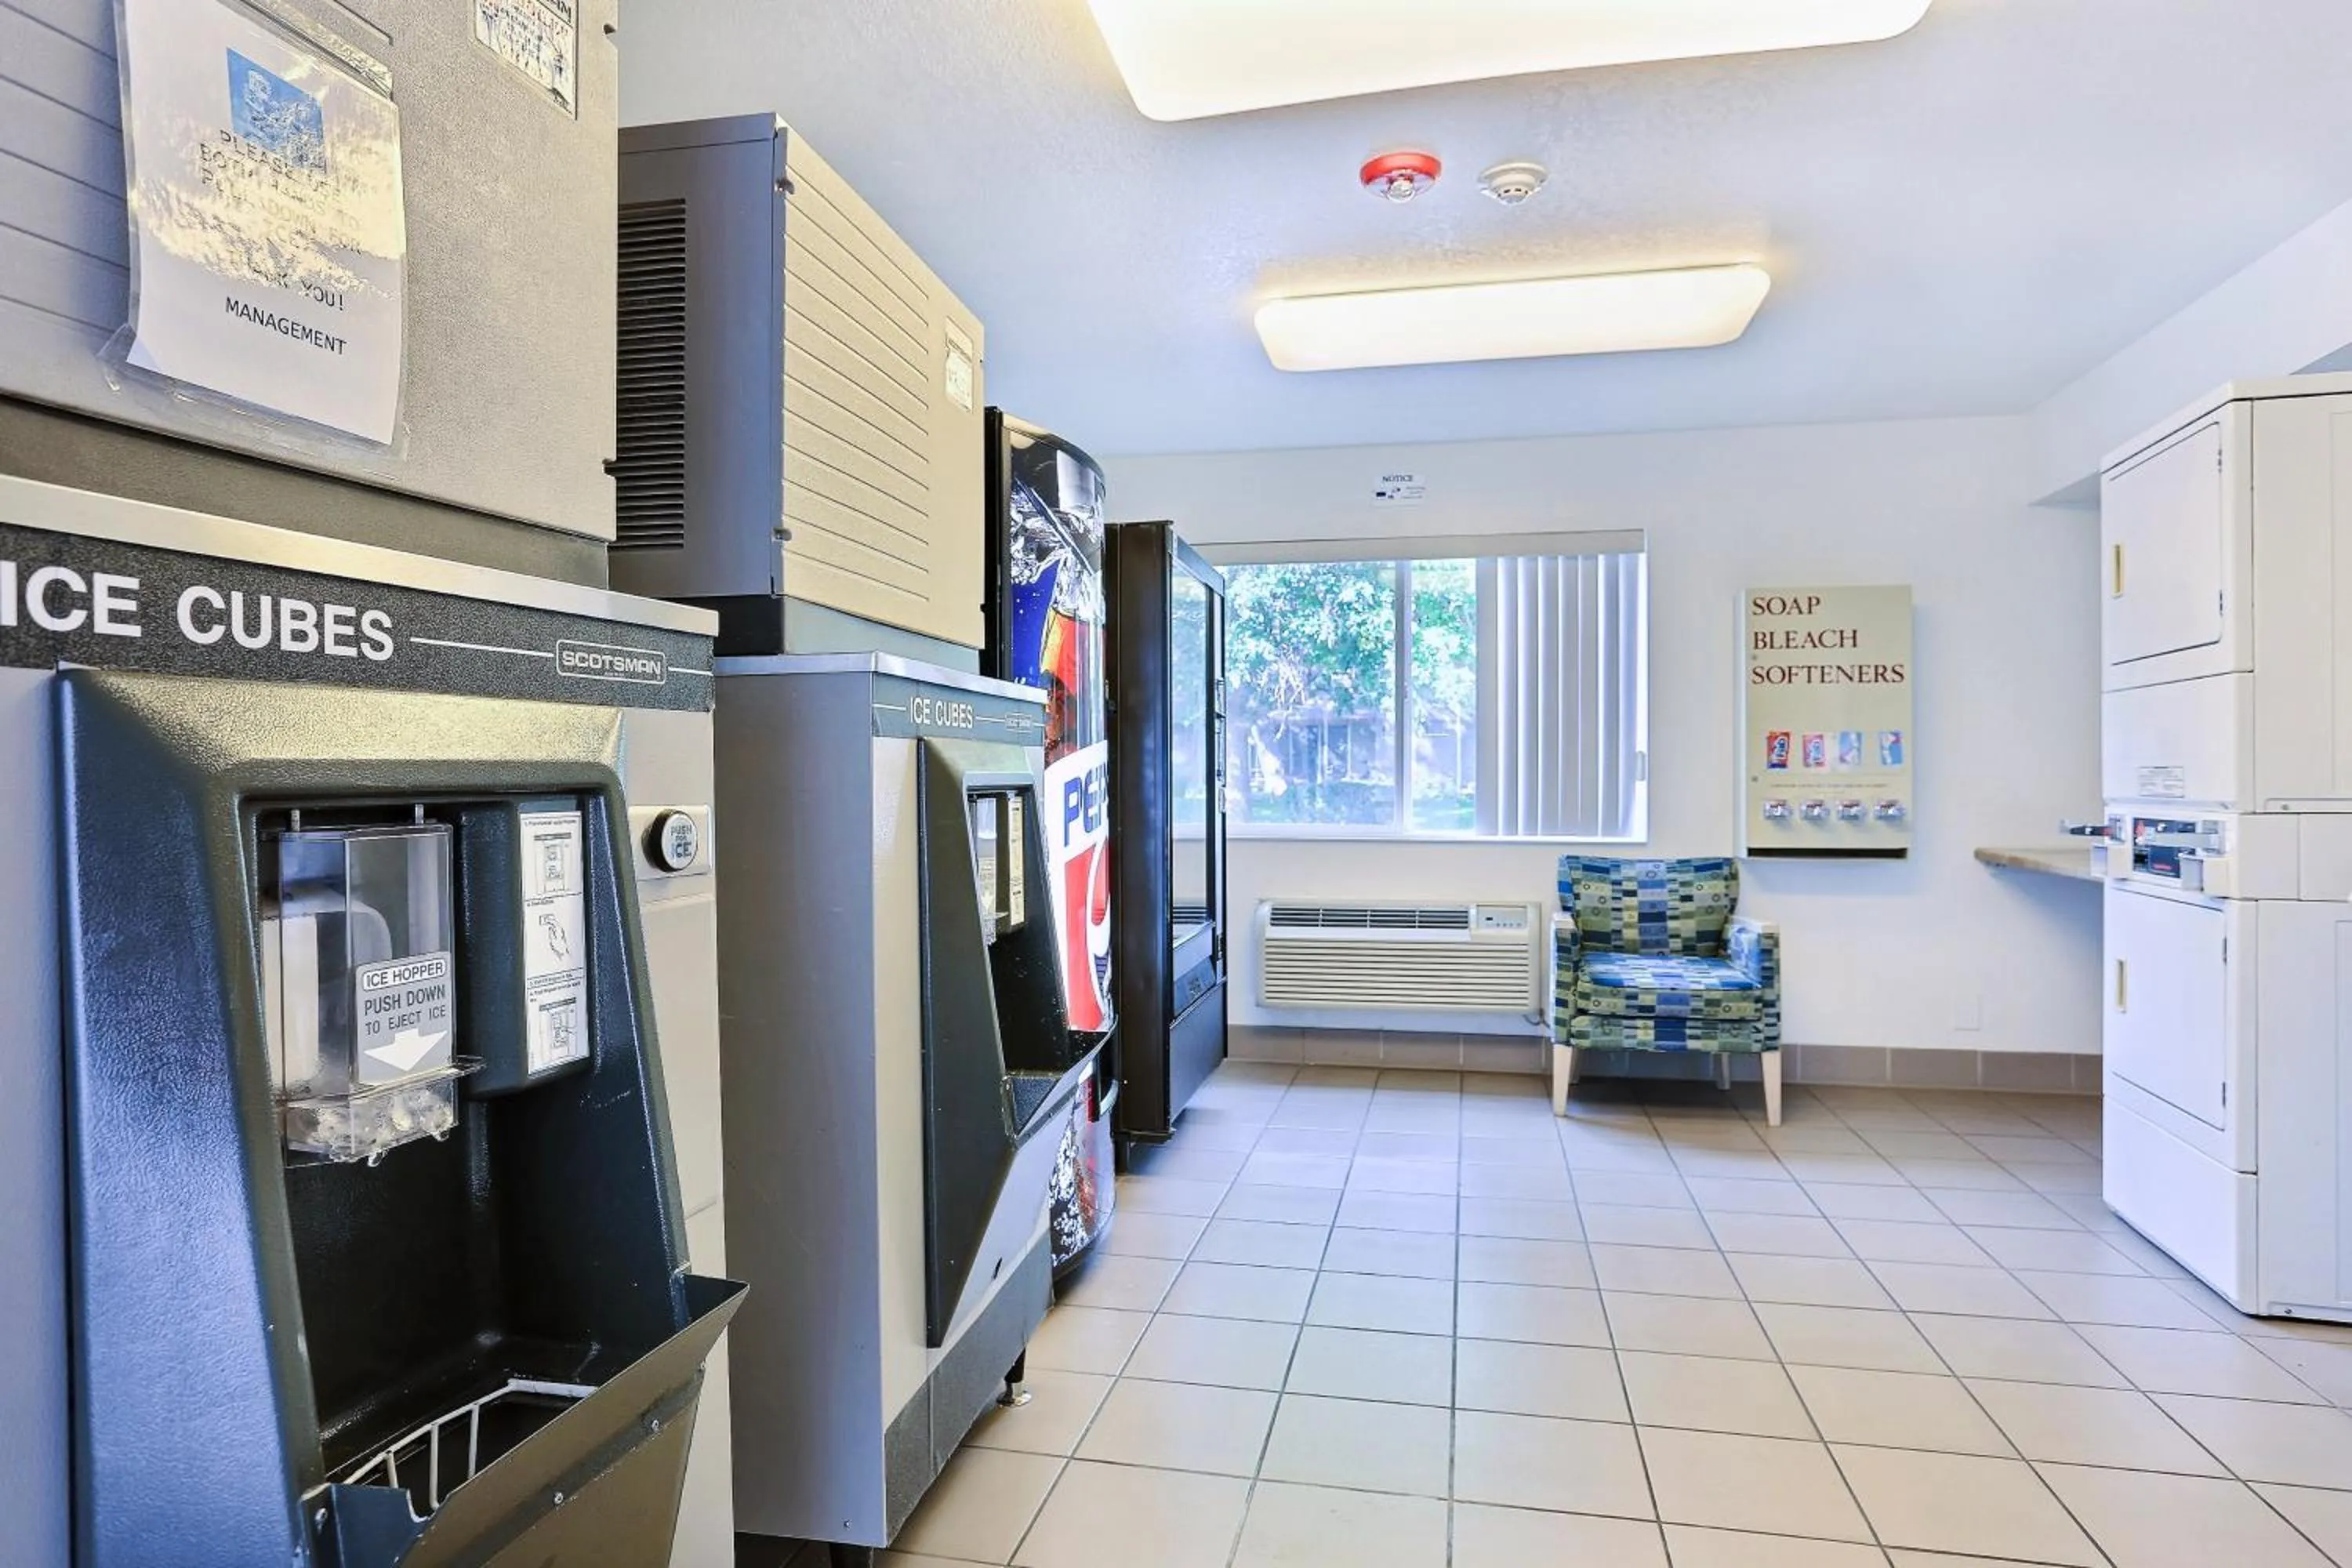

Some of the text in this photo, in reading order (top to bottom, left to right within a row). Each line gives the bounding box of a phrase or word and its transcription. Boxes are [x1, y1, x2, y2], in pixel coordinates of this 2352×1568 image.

[301, 278, 343, 311] YOU!
[225, 296, 347, 355] MANAGEMENT
[0, 560, 394, 662] ICE CUBES
[1752, 596, 1820, 616] SOAP
[1753, 629, 1858, 650] BLEACH
[562, 650, 661, 675] SCOTSMAN
[1751, 663, 1905, 684] SOFTENERS
[910, 696, 973, 729] ICE CUBES
[671, 824, 692, 837] PUSH
[671, 841, 692, 858] ICE
[366, 962, 443, 988] ICE HOPPER
[365, 985, 445, 1016] PUSH DOWN
[365, 1004, 446, 1036] TO EJECT ICE
